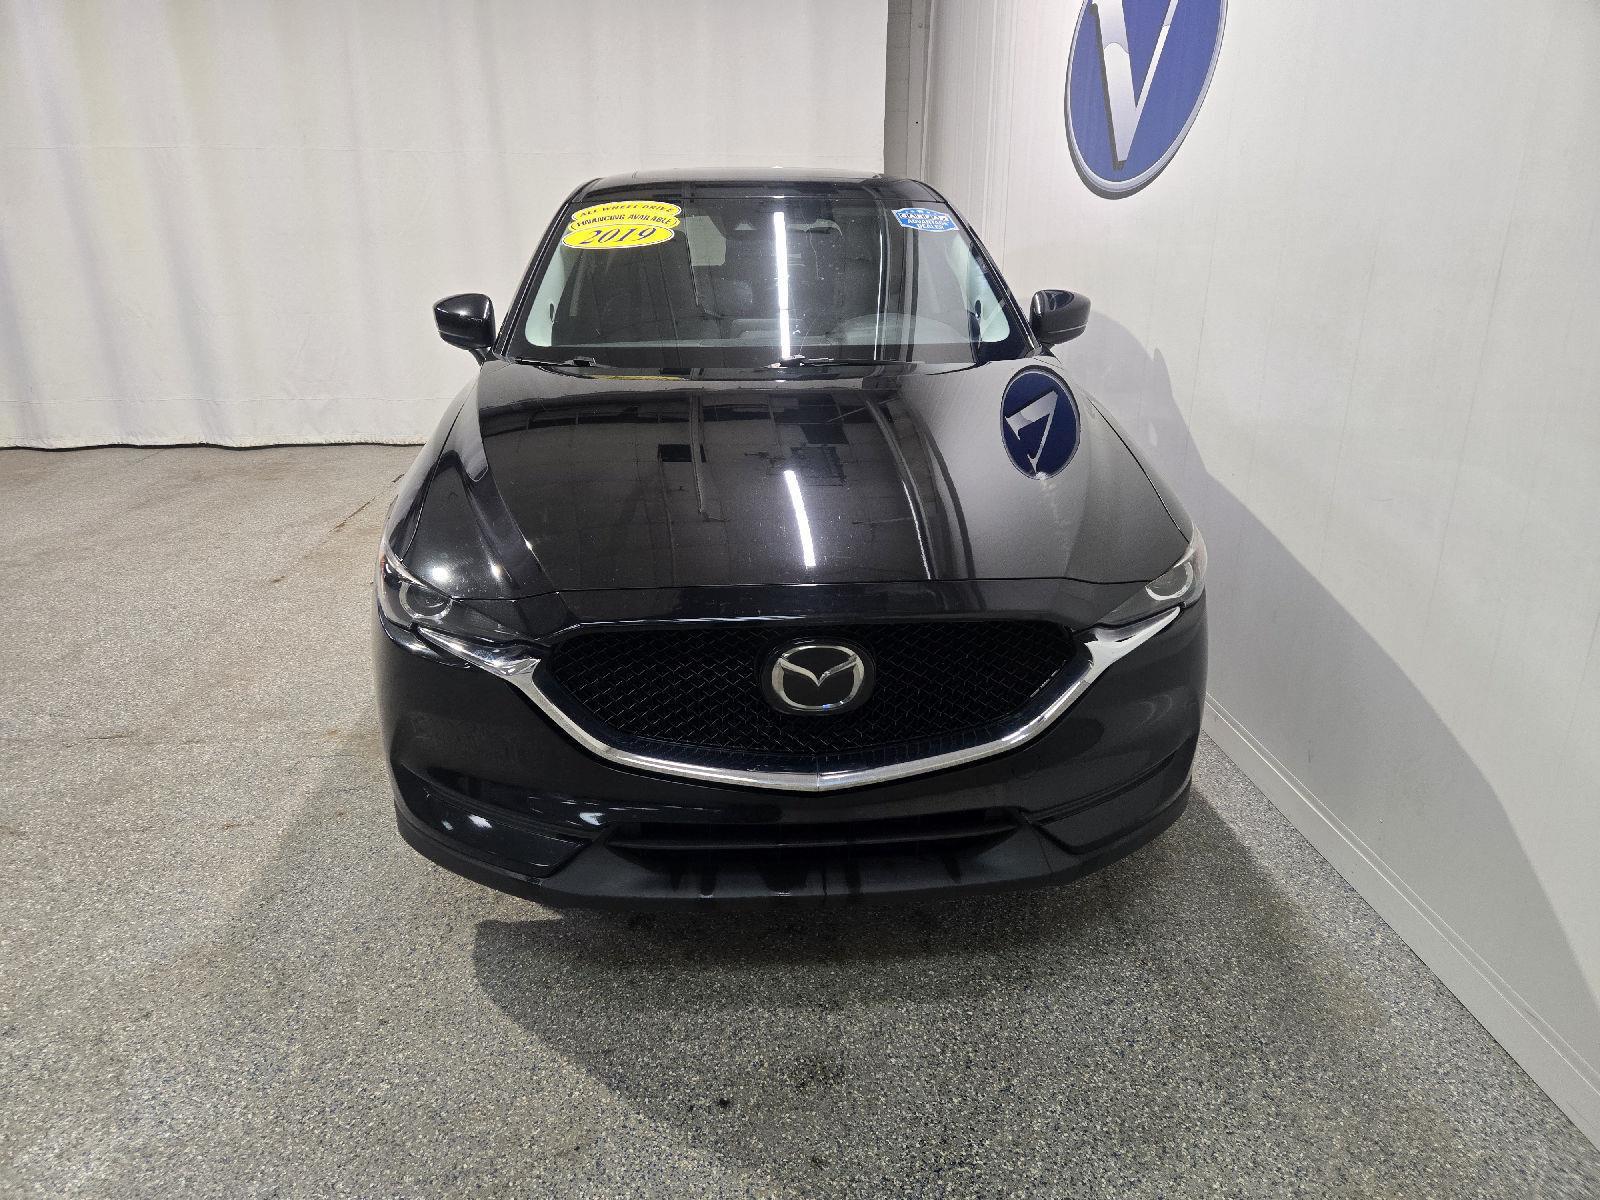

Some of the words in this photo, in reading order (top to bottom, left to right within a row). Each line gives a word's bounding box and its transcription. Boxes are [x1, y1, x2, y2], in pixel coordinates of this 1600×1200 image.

[576, 214, 626, 227] FINANCING
[627, 213, 673, 225] AVAILABLE
[578, 227, 657, 245] 2019
